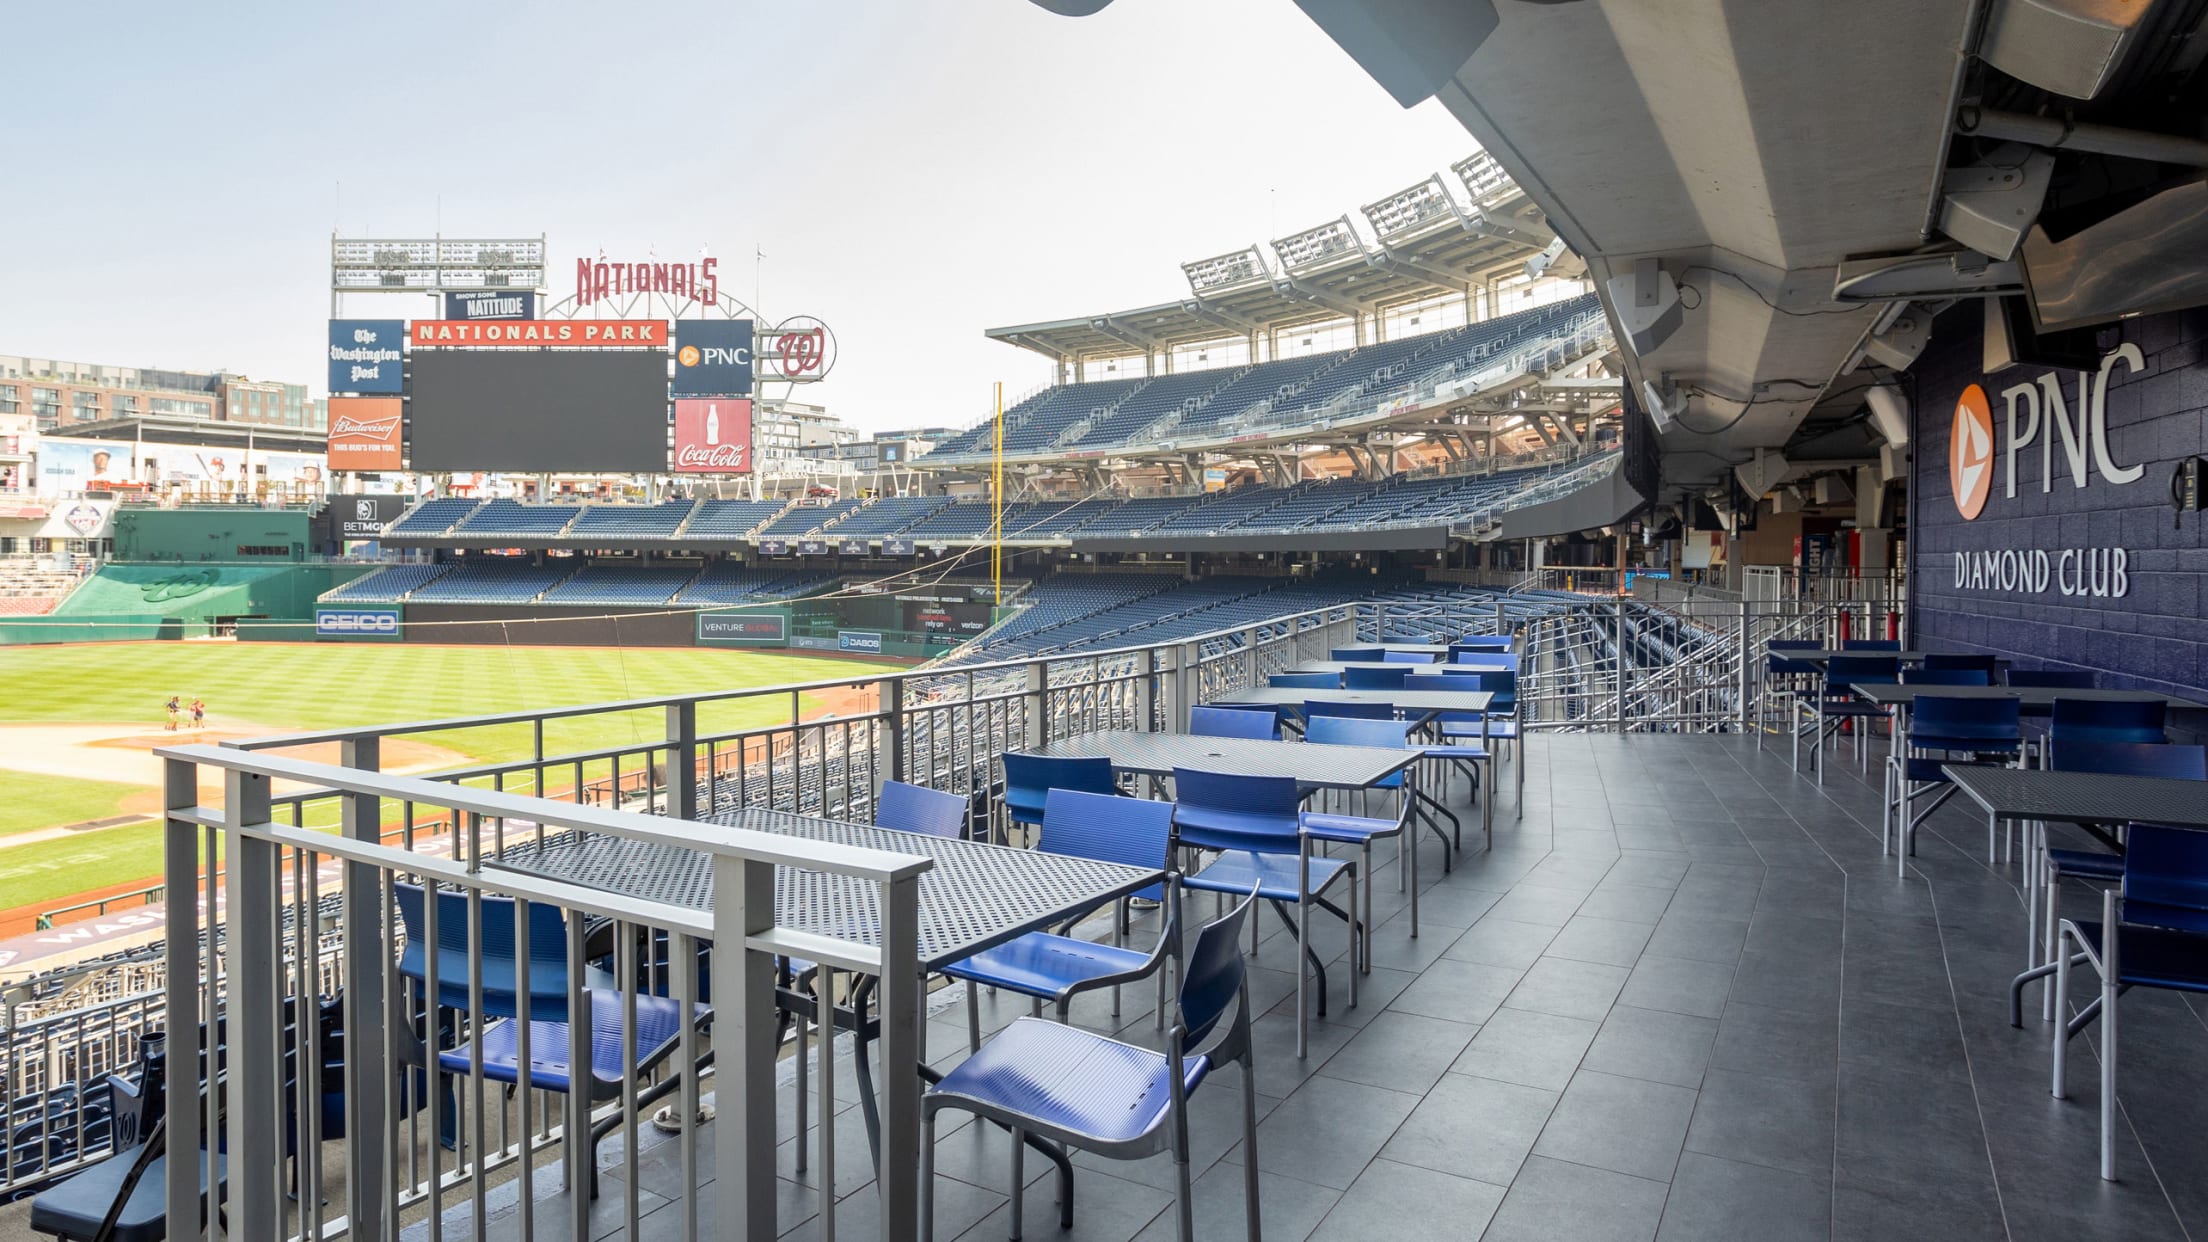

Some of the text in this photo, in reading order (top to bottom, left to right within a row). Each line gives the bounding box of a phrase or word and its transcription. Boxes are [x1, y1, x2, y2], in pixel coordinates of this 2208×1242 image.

[577, 257, 717, 306] NATIONALS
[477, 291, 497, 299] SOME
[467, 296, 523, 316] NATITUDE
[354, 329, 377, 343] The
[419, 325, 653, 340] NATIONALS PARK
[330, 344, 401, 363] Washington
[702, 347, 749, 365] PNC
[351, 366, 380, 382] Post
[335, 420, 392, 433] Budweiser
[2001, 342, 2145, 499] PNC
[1955, 548, 2128, 597] DIAMOND CLUB
[320, 614, 396, 631] GEICO
[704, 623, 745, 632] VENTURE
